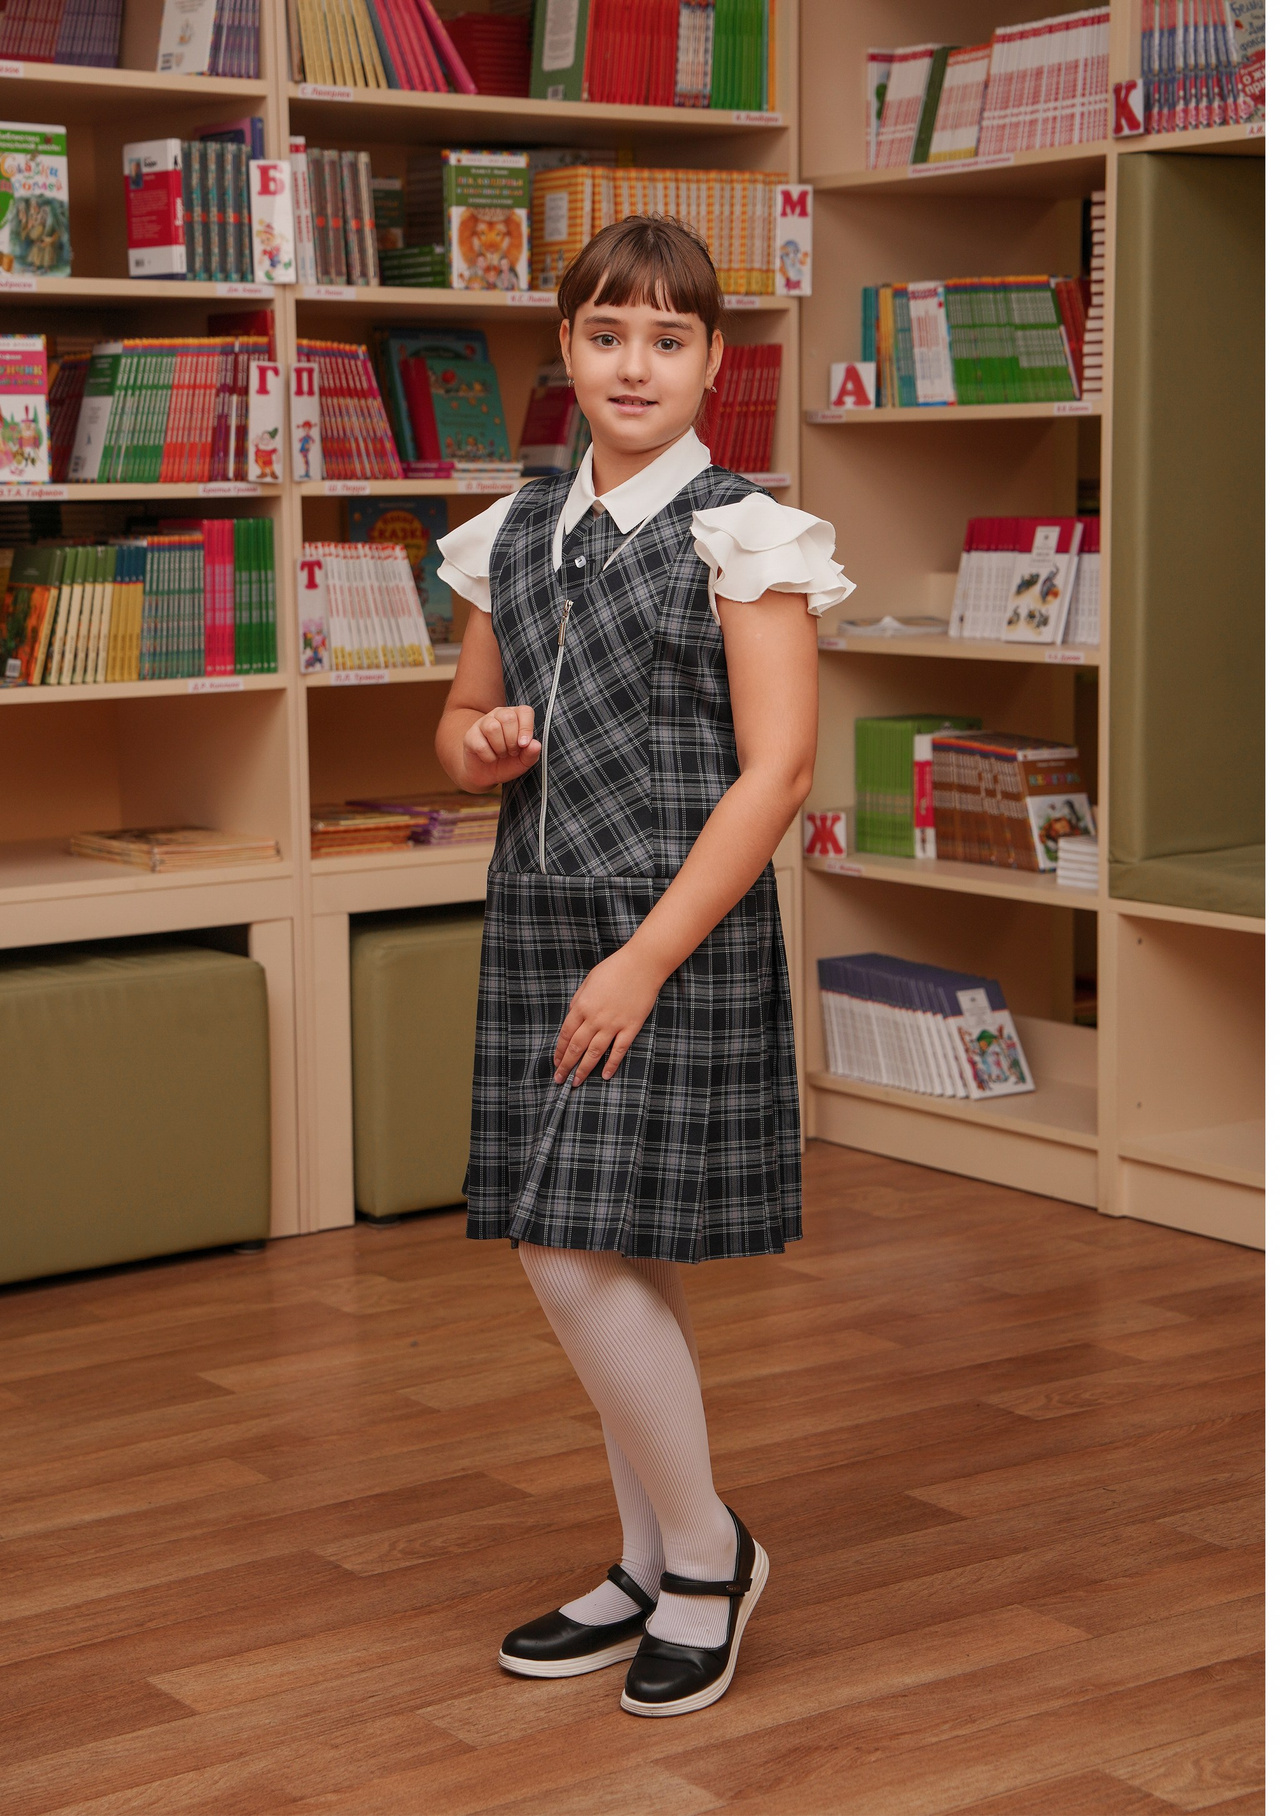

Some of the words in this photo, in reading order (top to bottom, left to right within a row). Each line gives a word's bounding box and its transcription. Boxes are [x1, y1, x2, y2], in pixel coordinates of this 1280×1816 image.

[1114, 81, 1141, 133] К
[257, 164, 286, 196] Б
[780, 190, 810, 218] М
[256, 365, 279, 395] Г
[294, 367, 315, 396] П
[833, 363, 871, 407] А
[300, 560, 323, 590] Т
[806, 813, 845, 855] Ж
